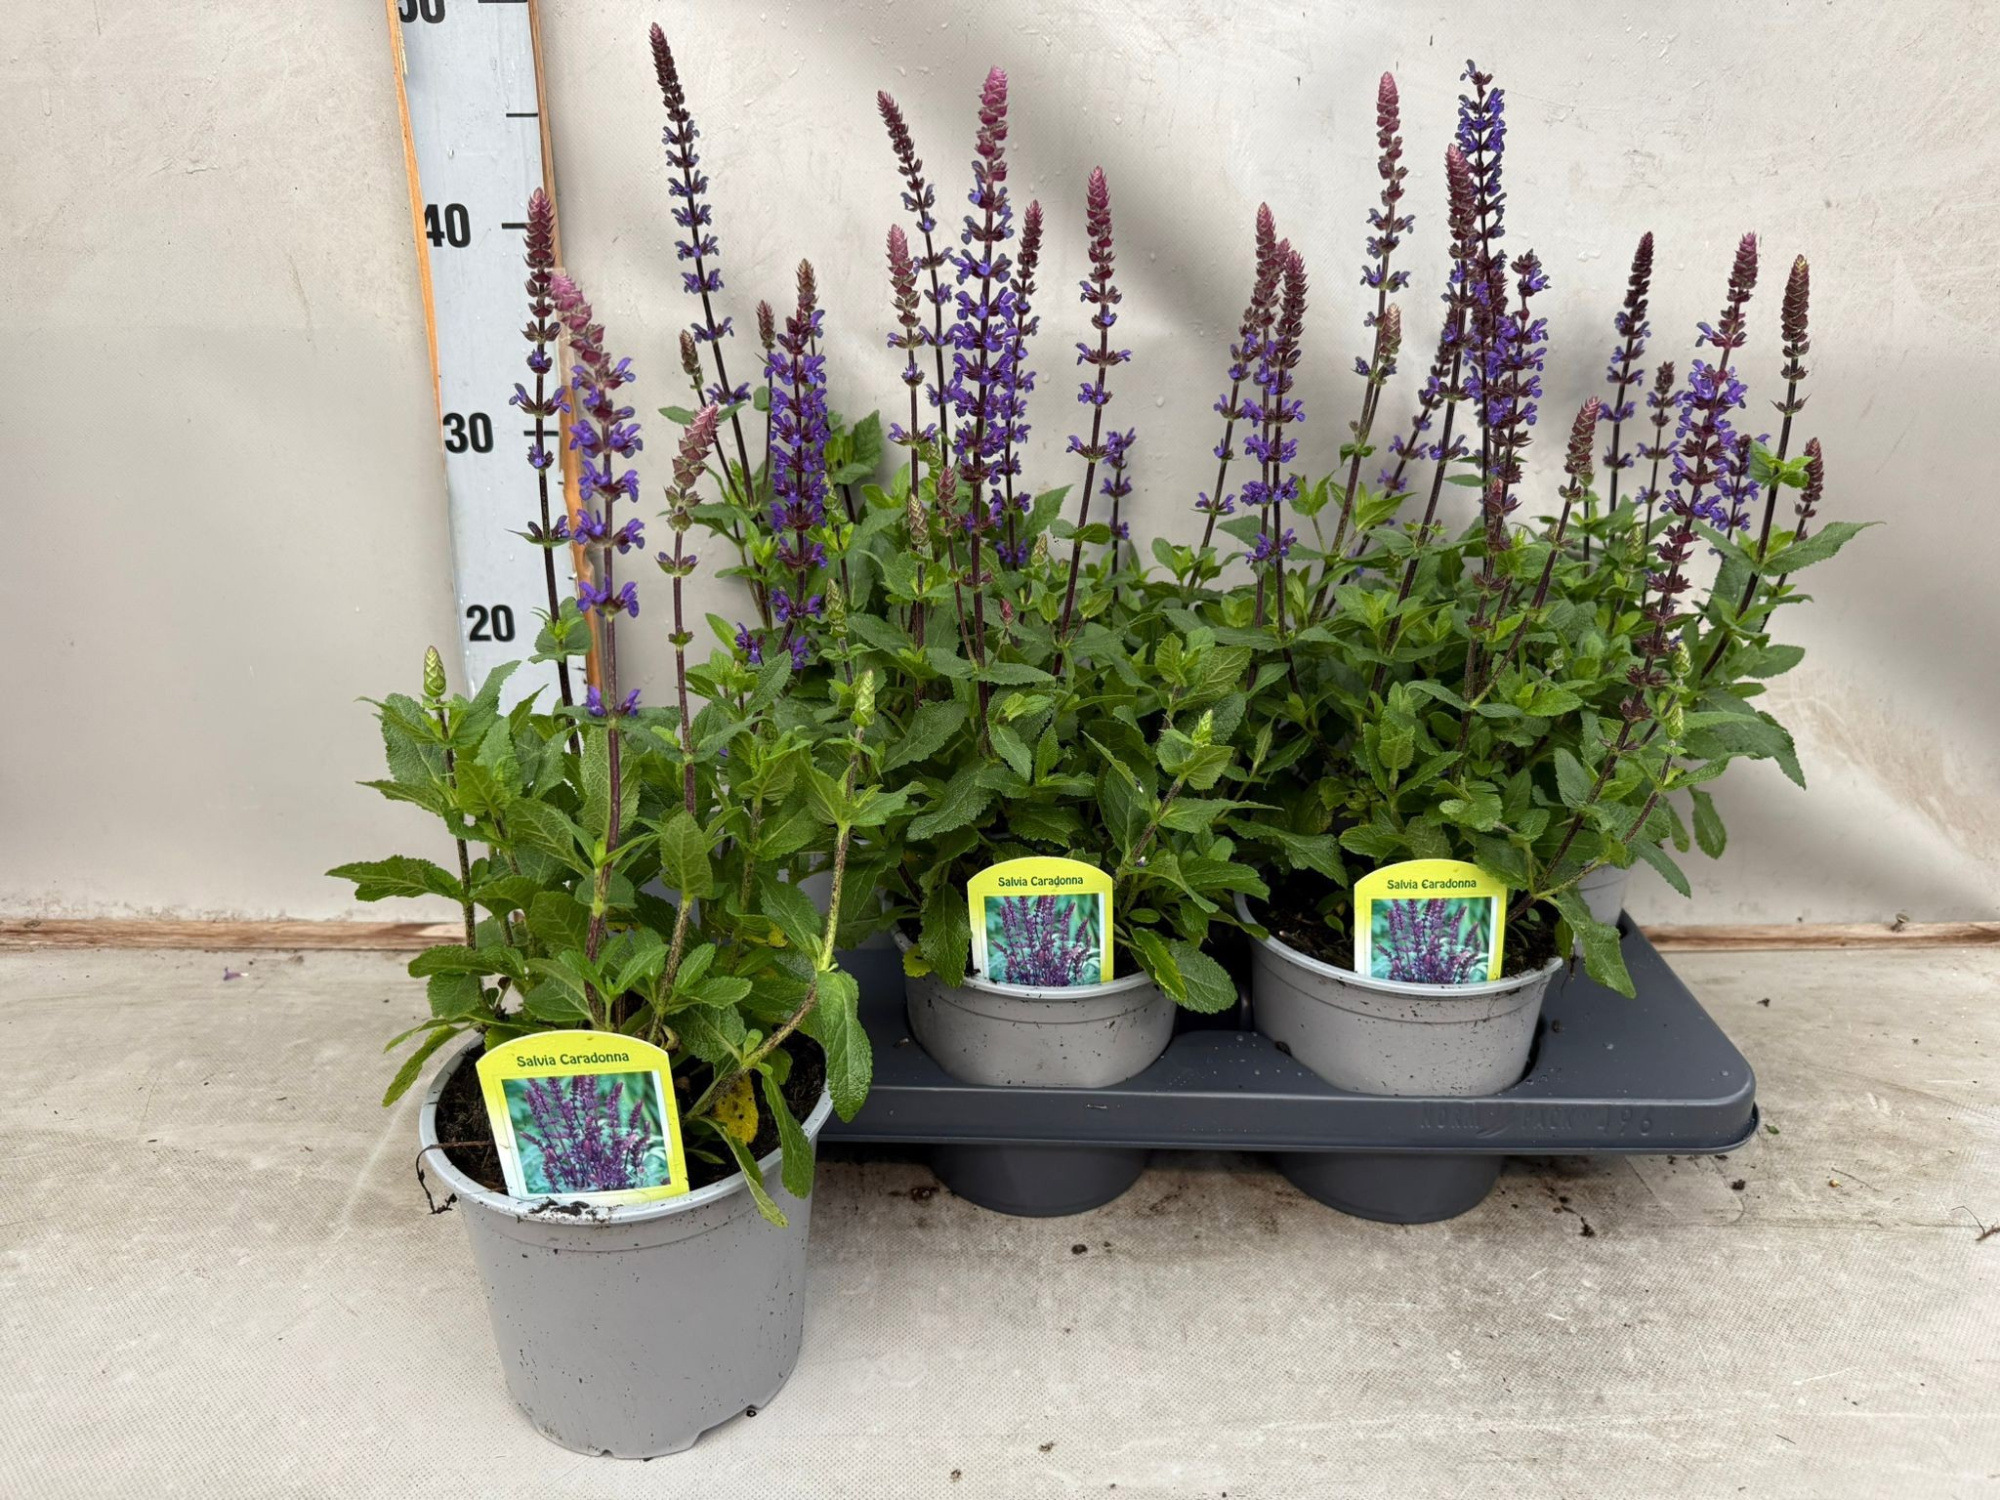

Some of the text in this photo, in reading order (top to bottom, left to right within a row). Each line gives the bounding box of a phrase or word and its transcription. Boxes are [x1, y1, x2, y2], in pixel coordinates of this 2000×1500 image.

[424, 203, 471, 248] 40
[443, 412, 494, 454] 30
[466, 604, 516, 642] 20
[998, 875, 1084, 887] Salvia Caradonna
[1387, 878, 1477, 890] Salvia Caradonna
[516, 1052, 630, 1068] Salvia Caradonna
